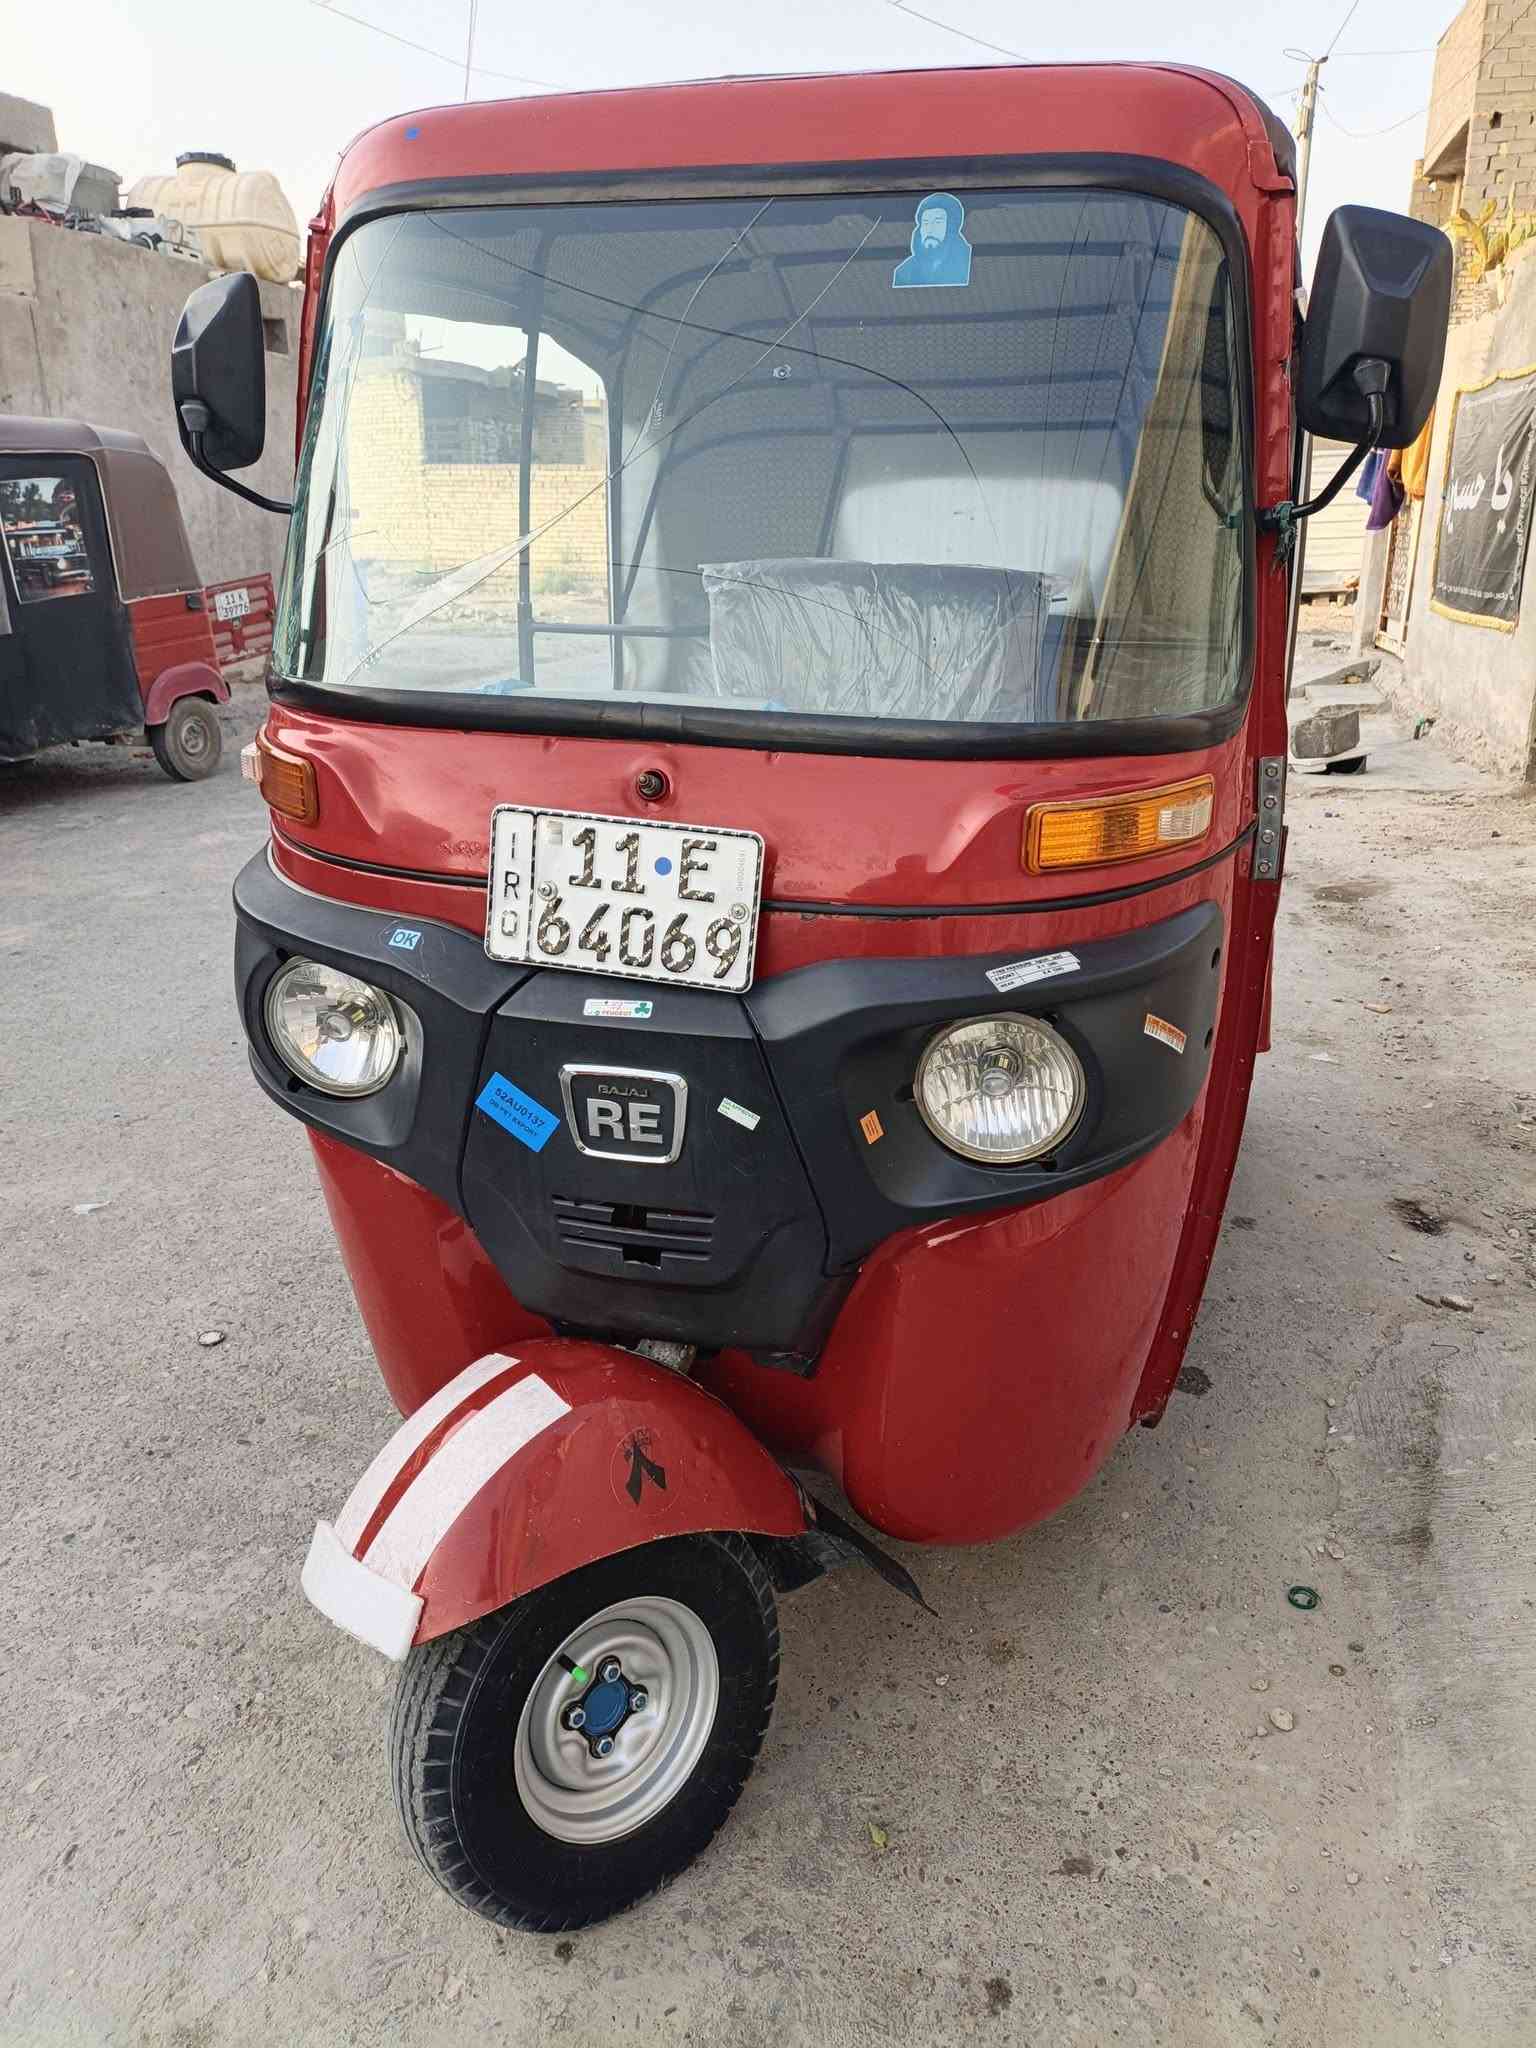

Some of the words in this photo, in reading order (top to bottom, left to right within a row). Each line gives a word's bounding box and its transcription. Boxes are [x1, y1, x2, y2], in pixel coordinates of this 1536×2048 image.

[569, 827, 645, 894] 11
[678, 838, 717, 902] E
[393, 931, 418, 947] OK
[536, 897, 742, 979] 64069
[598, 1084, 649, 1098] BAJAJ
[587, 1098, 663, 1144] RE
